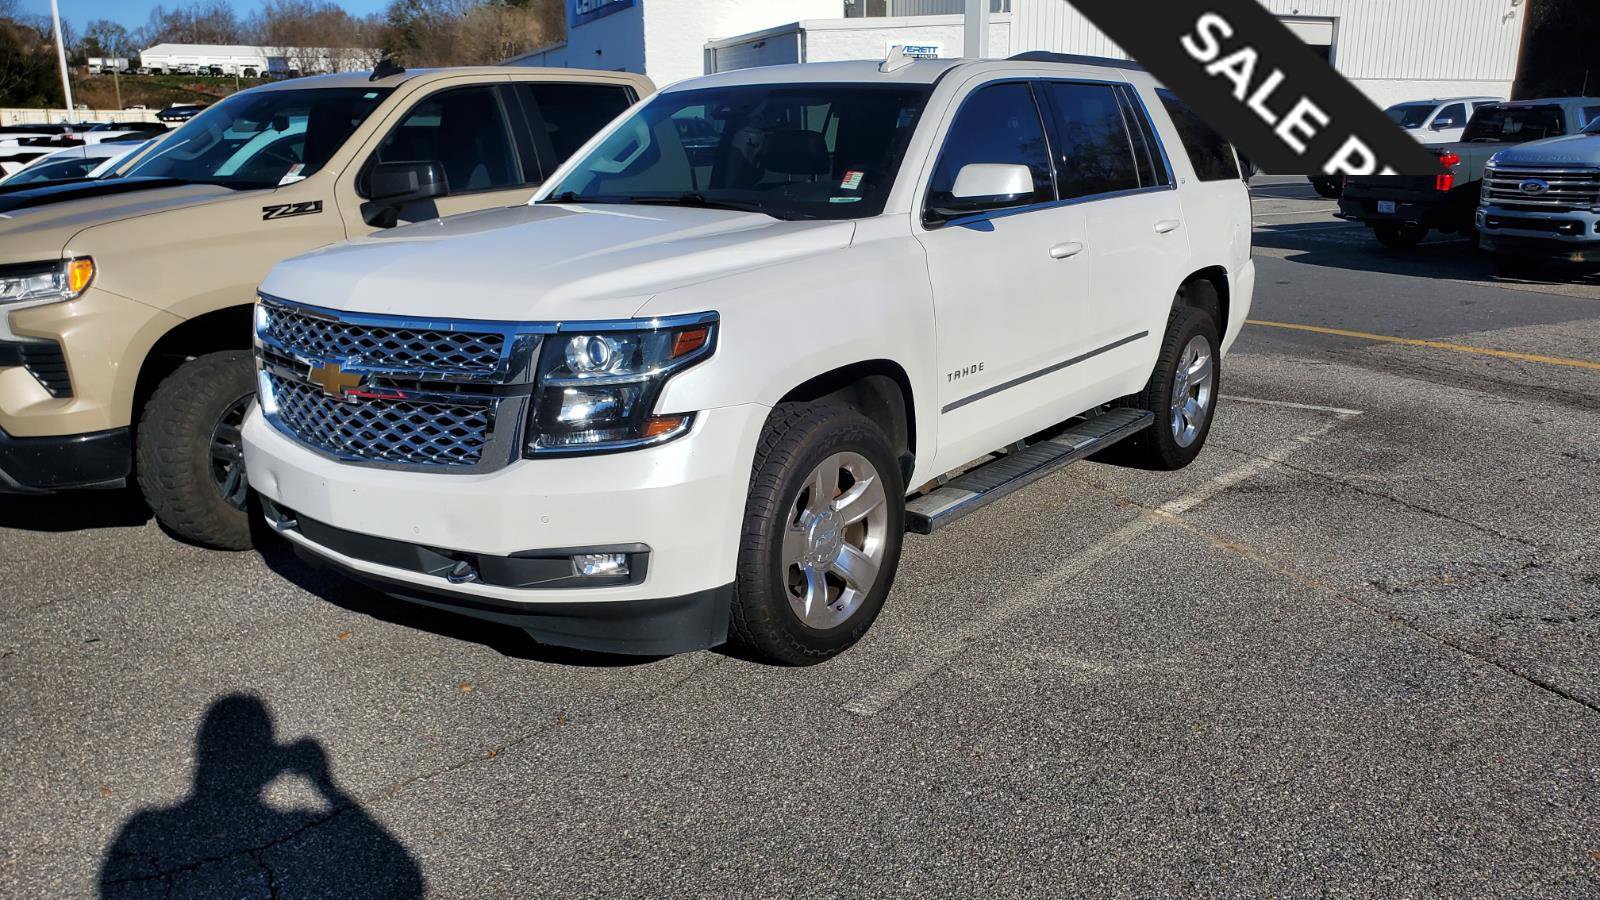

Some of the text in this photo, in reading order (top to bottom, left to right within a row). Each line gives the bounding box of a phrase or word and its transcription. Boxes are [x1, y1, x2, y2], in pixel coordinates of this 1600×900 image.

[892, 45, 939, 54] VERETT
[262, 199, 323, 220] Z71
[947, 361, 985, 382] TAHOE
